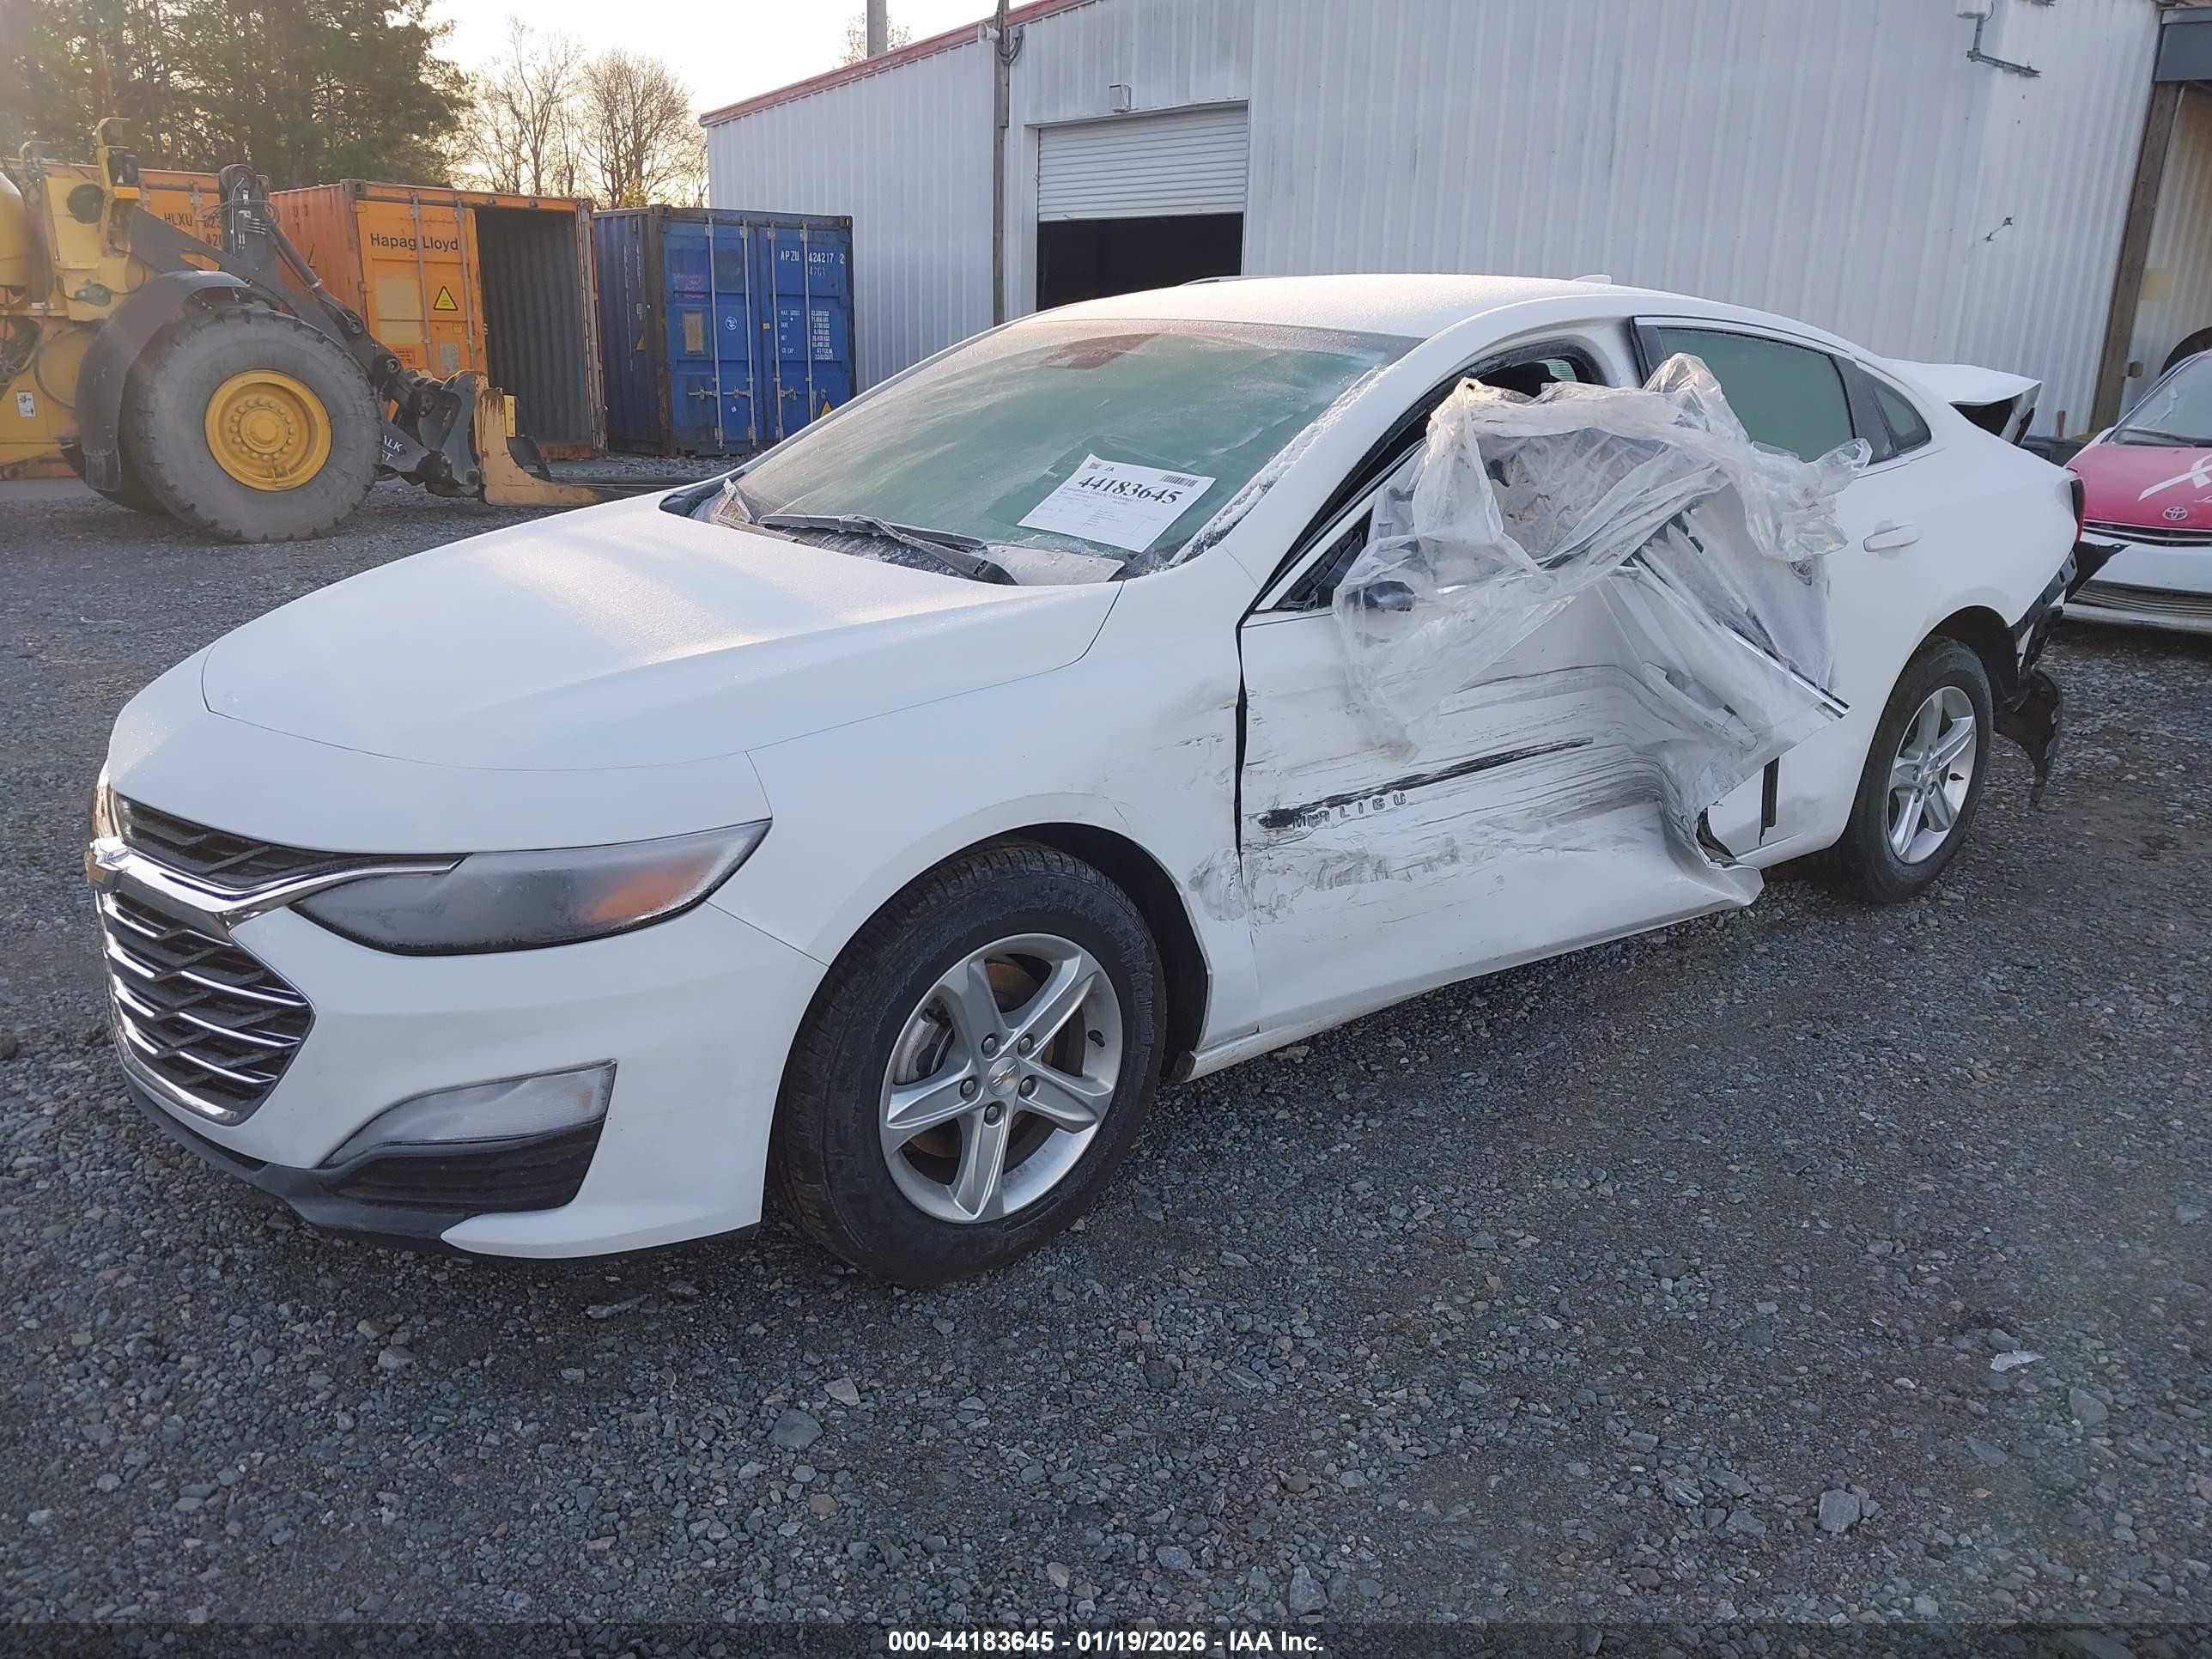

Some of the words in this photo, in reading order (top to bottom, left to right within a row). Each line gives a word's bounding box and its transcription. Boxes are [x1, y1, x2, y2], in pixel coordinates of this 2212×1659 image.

[370, 233, 416, 251] Hapag
[422, 235, 459, 252] Lloyd
[781, 250, 799, 261] APZU
[808, 252, 834, 264] 424217
[838, 253, 845, 264] 2
[1078, 476, 1184, 505] 44183645
